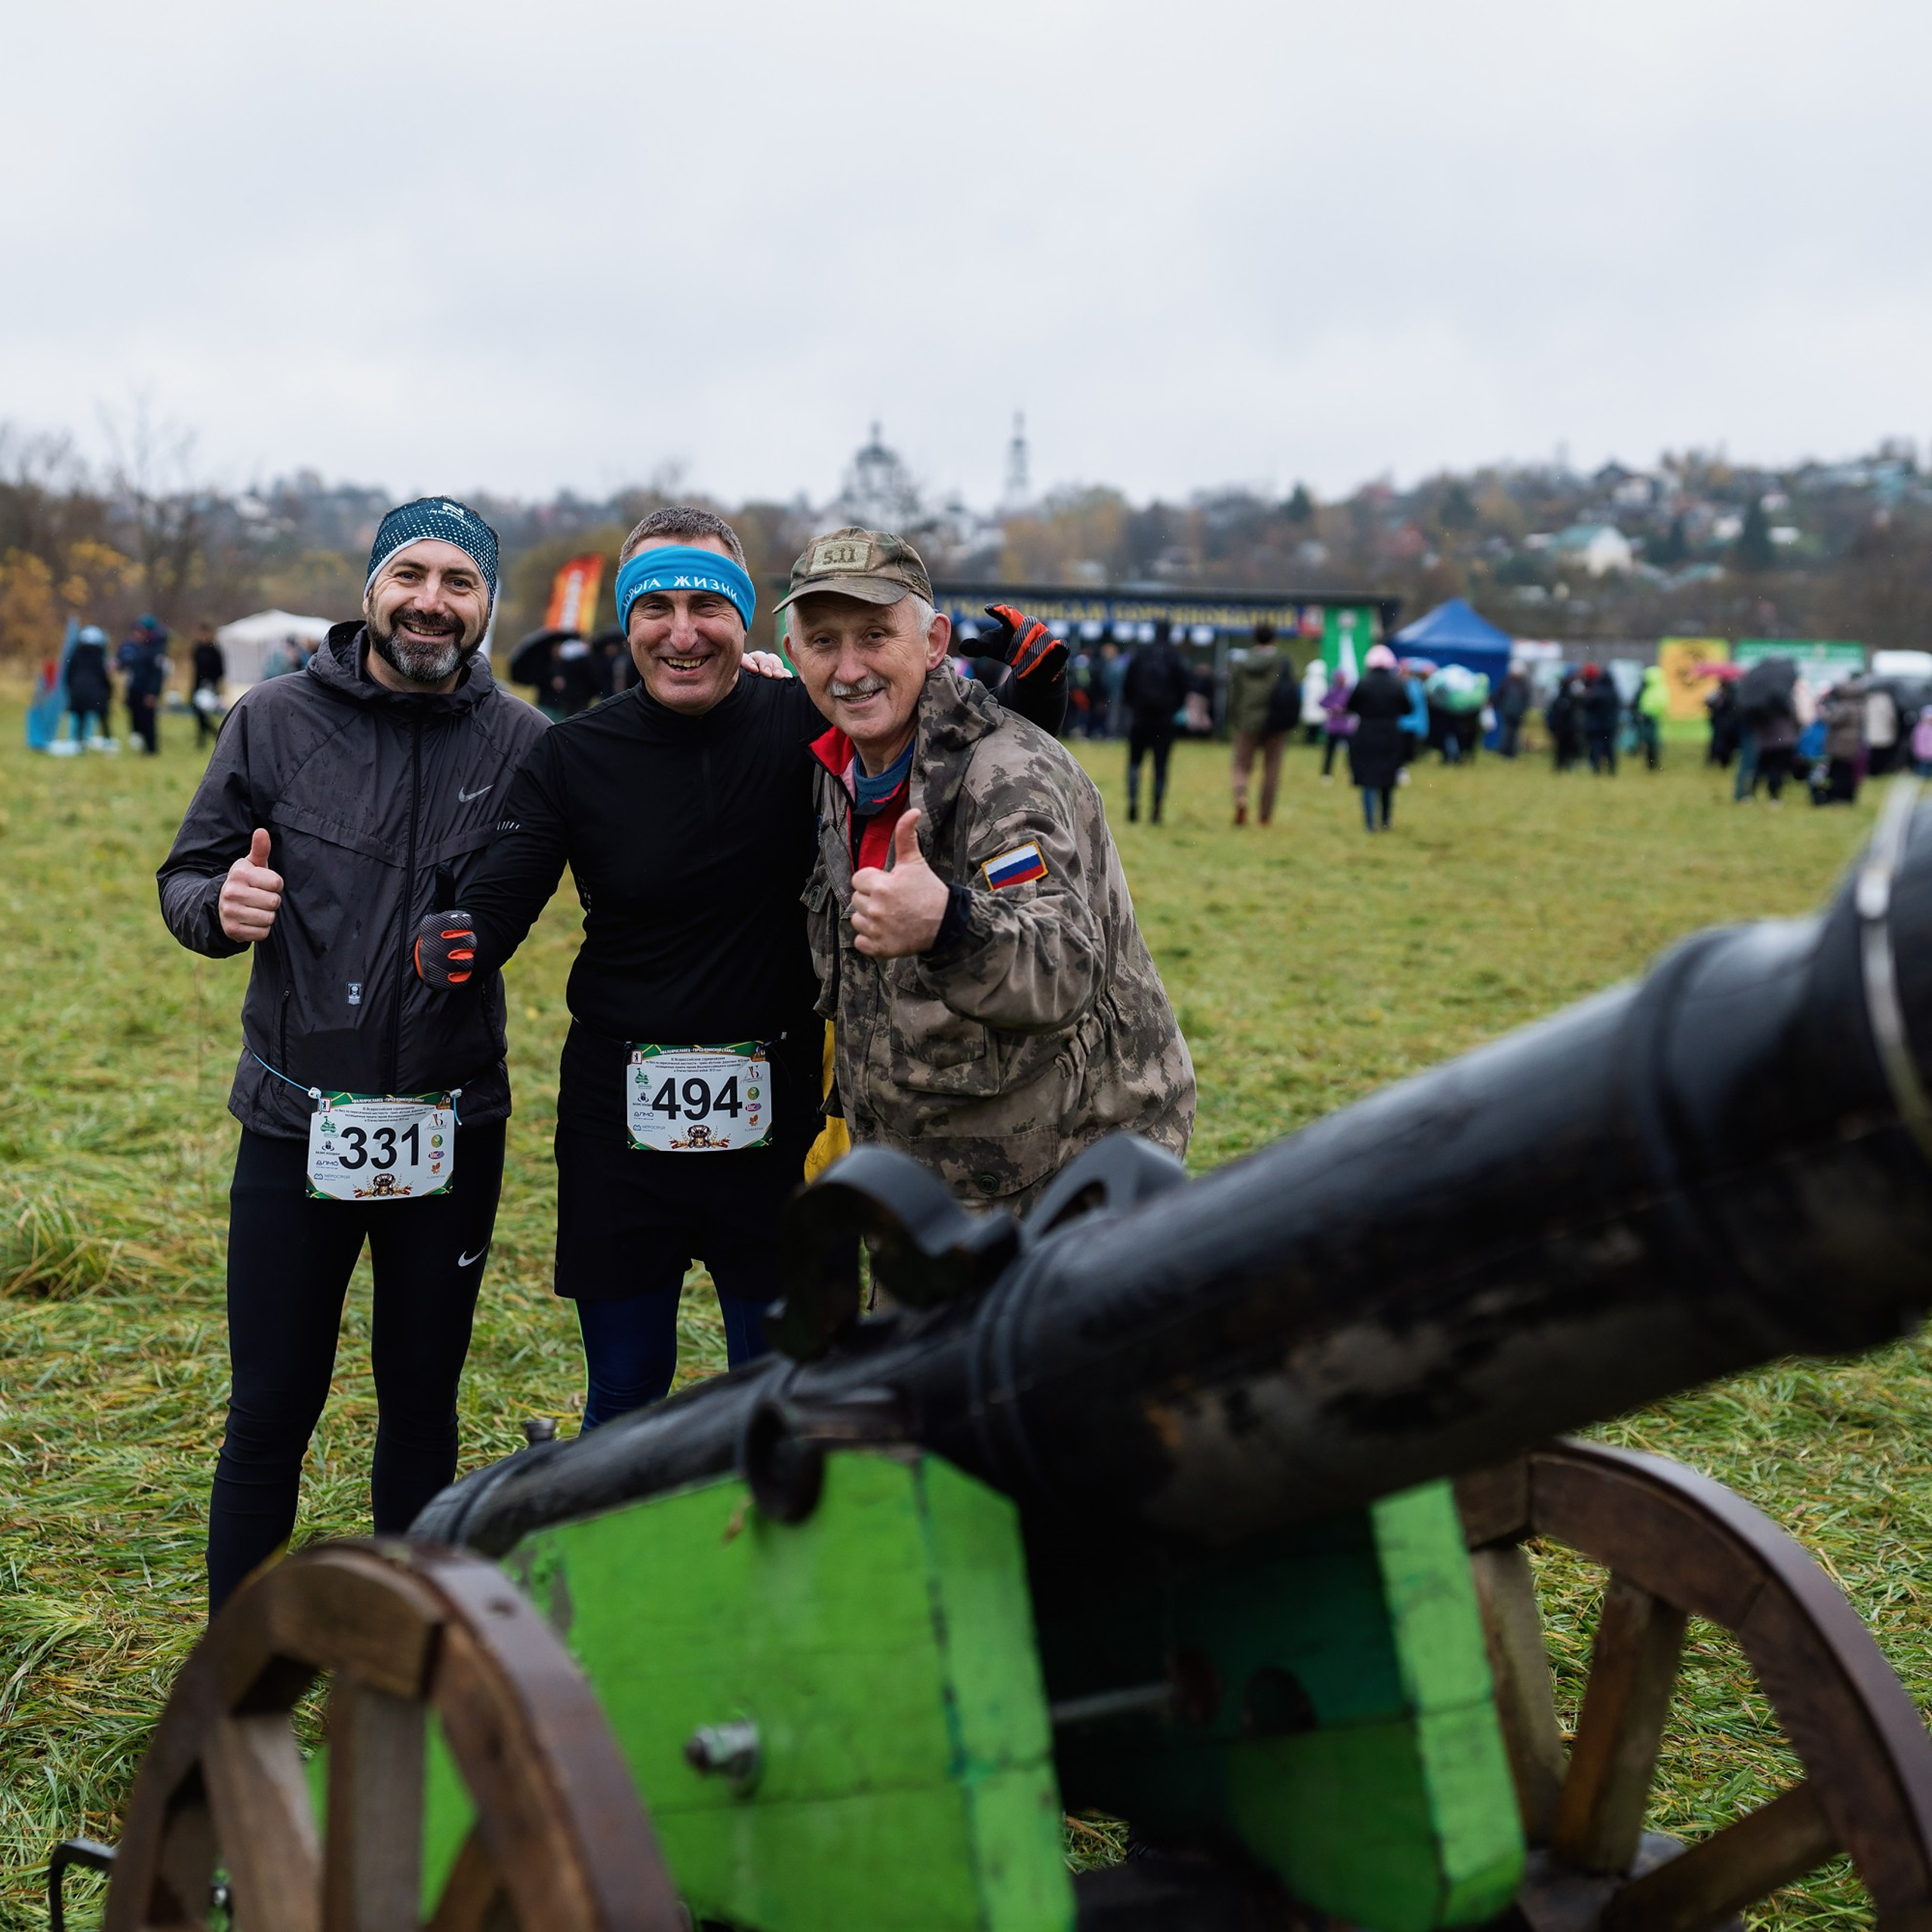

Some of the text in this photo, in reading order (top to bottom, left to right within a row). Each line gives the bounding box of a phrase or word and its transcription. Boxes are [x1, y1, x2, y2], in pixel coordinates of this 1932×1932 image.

[823, 547, 856, 565] 5.11
[652, 1075, 743, 1121] 494
[339, 1123, 419, 1170] 331
